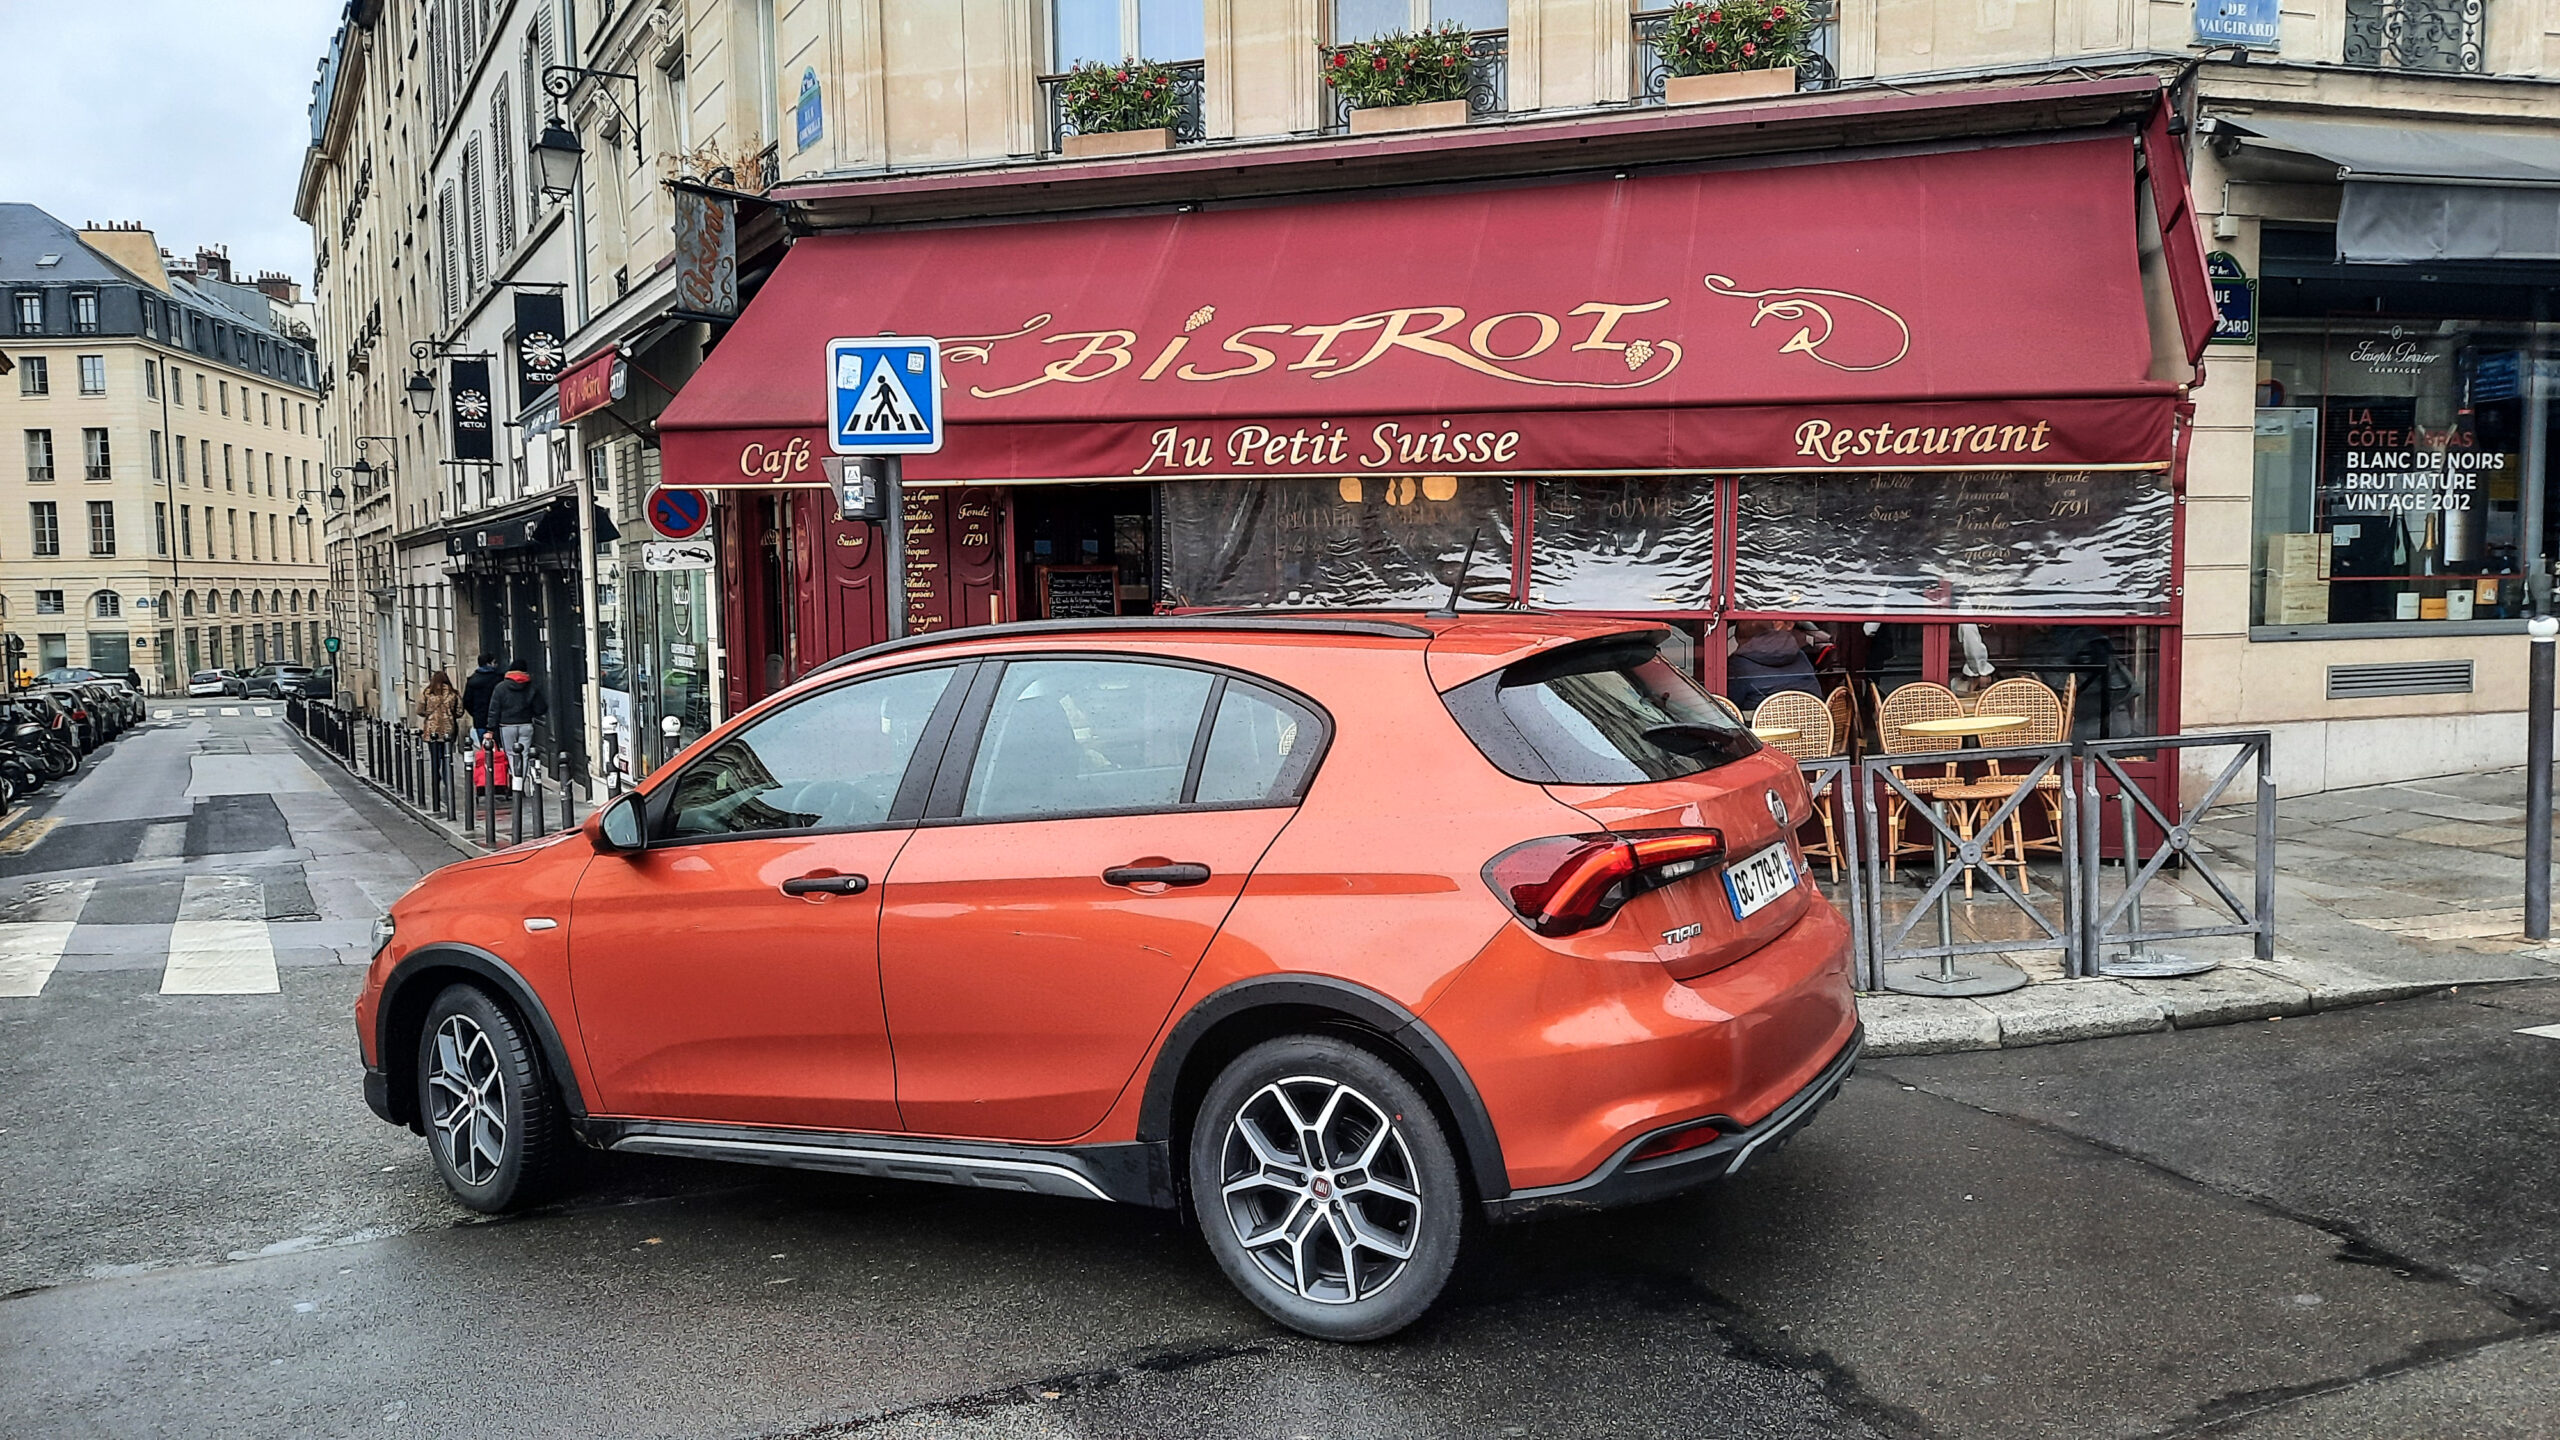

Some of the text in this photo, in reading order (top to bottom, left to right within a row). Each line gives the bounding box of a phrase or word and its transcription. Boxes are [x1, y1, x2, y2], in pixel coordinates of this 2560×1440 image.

[2228, 3, 2248, 16] DE
[2200, 18, 2274, 37] VAUGIRARD
[2215, 290, 2231, 303] UE
[2350, 341, 2440, 366] Joseph Perrier
[2349, 408, 2373, 425] LA
[1794, 419, 2051, 464] Restaurant
[2347, 426, 2399, 447] CÔTE
[2425, 431, 2474, 447] BRAS
[1133, 420, 1520, 476] Au Petit Suisse
[740, 437, 812, 483] Café
[2346, 452, 2505, 470] BLANC DE NOIRS
[2345, 473, 2477, 490] BRUT NATURE
[2050, 498, 2089, 518] 1791
[2345, 493, 2471, 511] VINTAGE 2012
[958, 503, 990, 520] Fondé
[836, 533, 864, 547] Suisse
[962, 533, 989, 546] 1791
